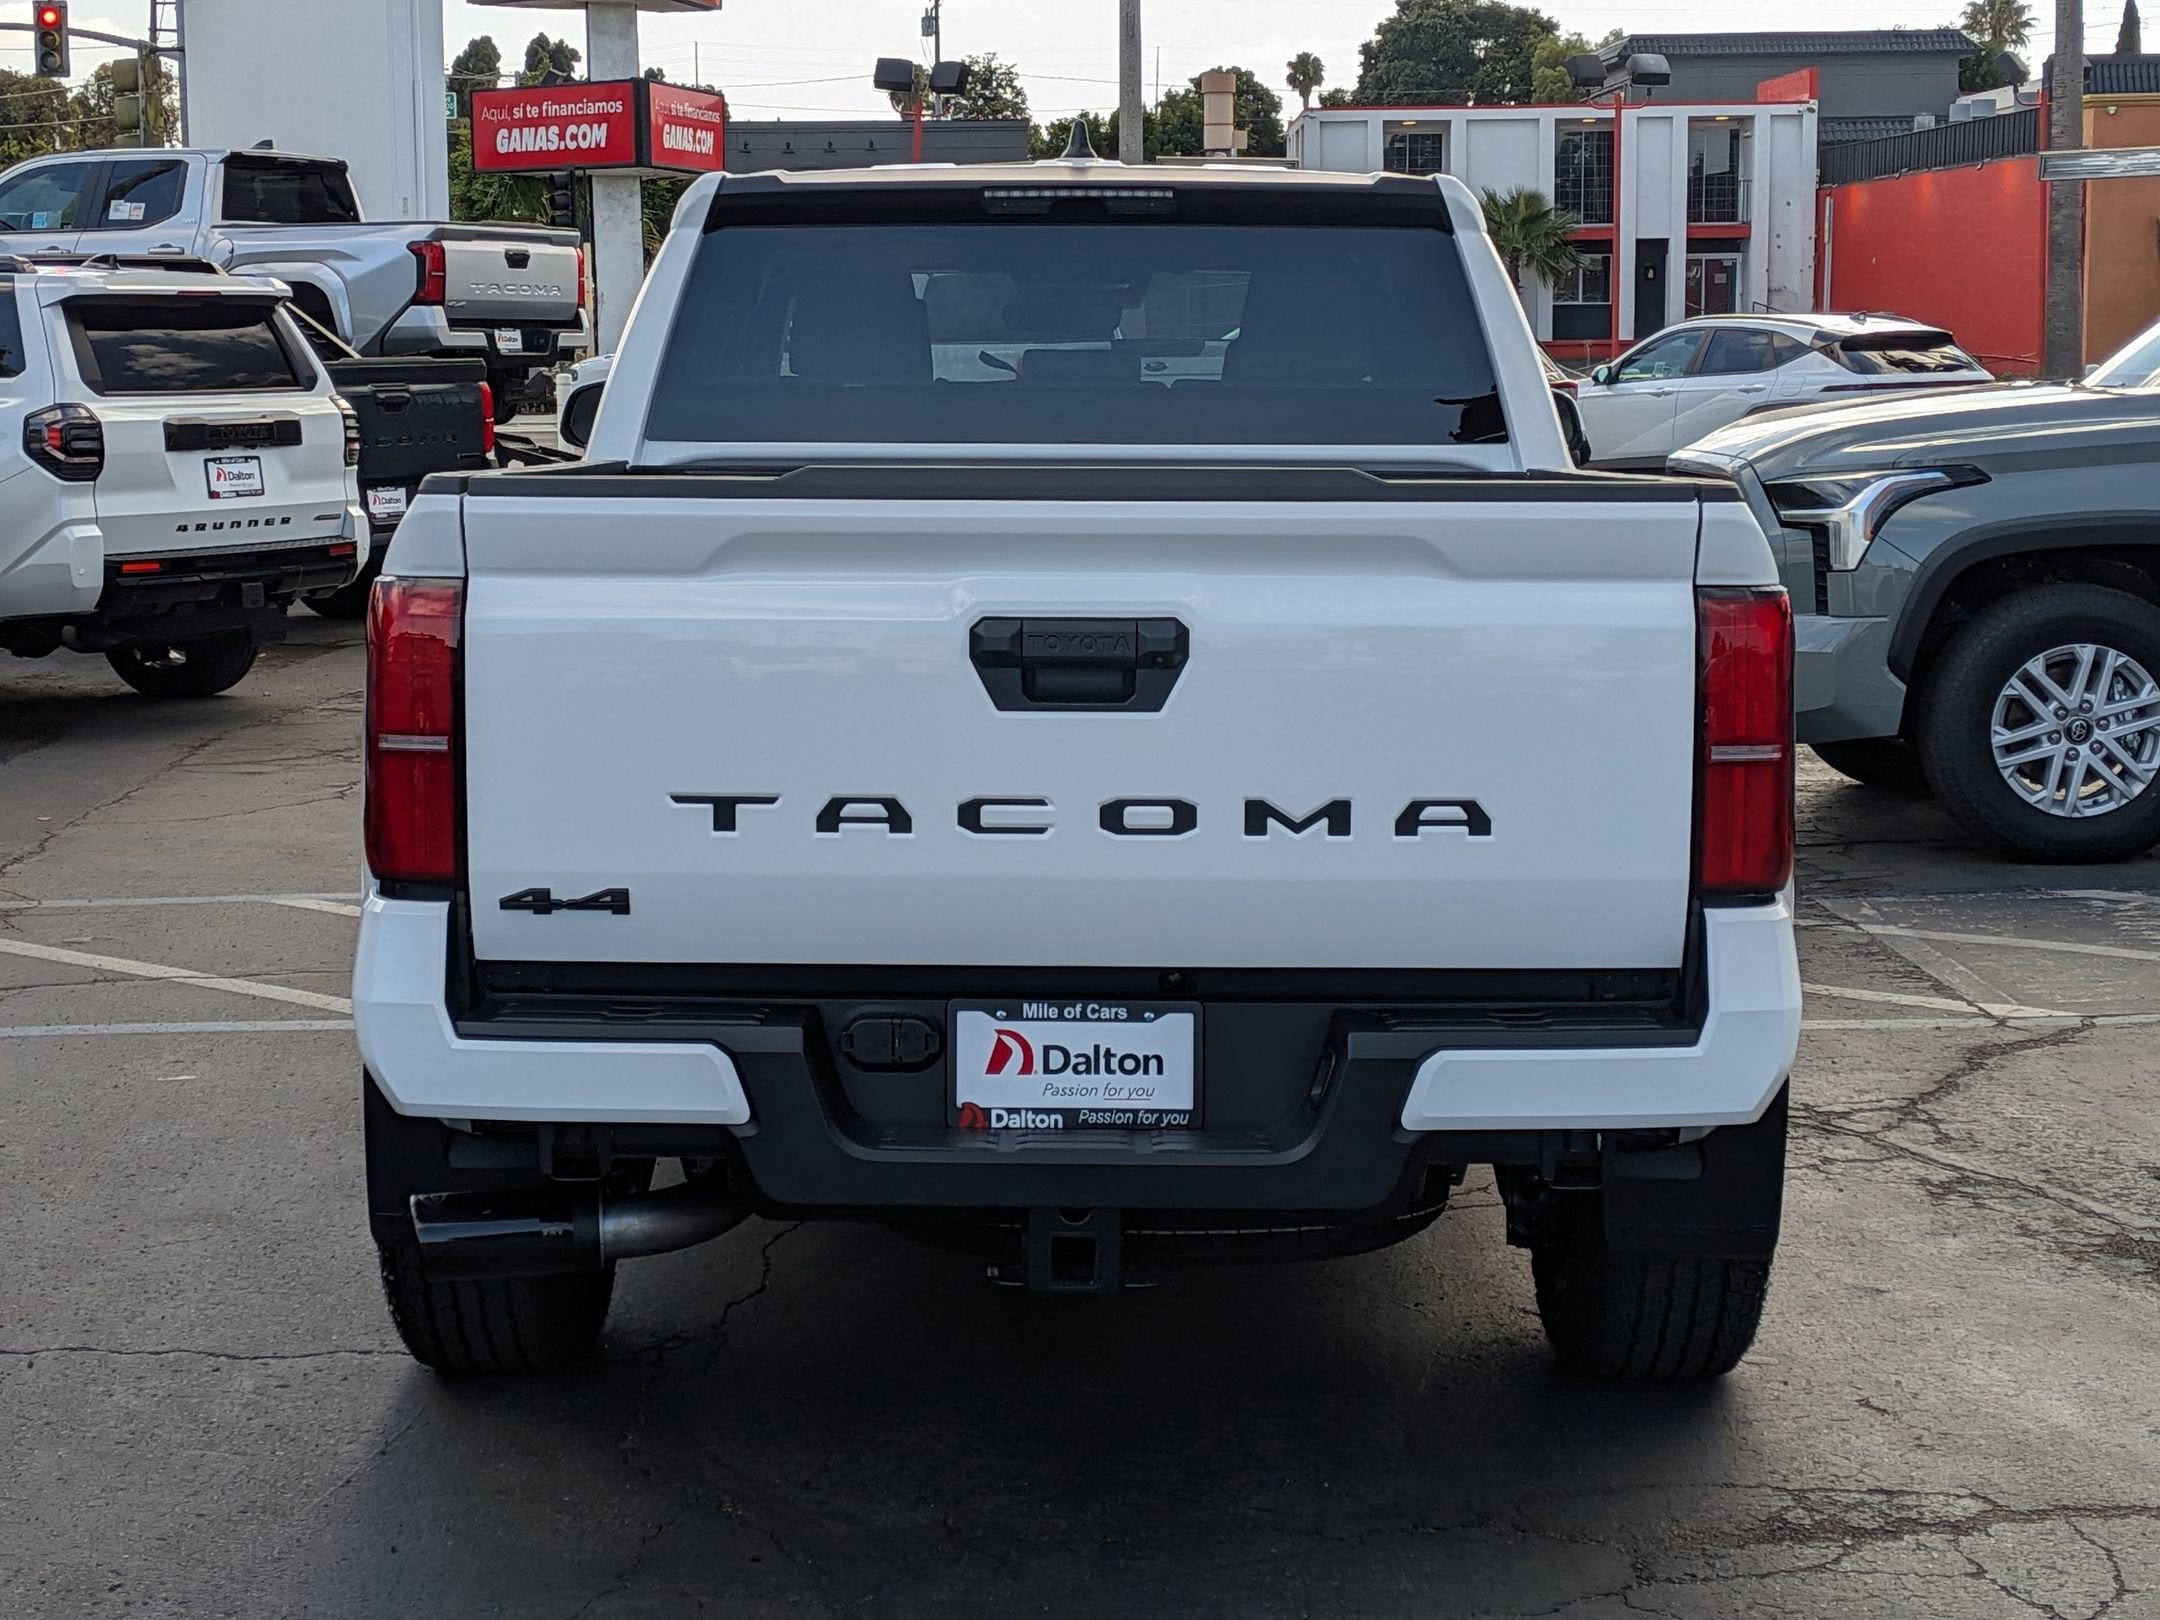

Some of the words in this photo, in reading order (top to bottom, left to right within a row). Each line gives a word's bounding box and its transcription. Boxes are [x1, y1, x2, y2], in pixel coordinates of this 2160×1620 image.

[481, 104, 511, 122] Aquí,
[513, 105, 524, 119] sí
[526, 104, 539, 118] te
[542, 98, 623, 117] financiamos
[496, 122, 607, 153] GANAS.COM
[663, 123, 714, 155] GANAS.COM
[470, 283, 561, 296] TACOMA
[227, 471, 255, 481] Dalton
[176, 516, 292, 533] 4RUNNER
[1027, 634, 1131, 653] TOYOTA
[669, 793, 1494, 837] TACOMA
[1023, 1003, 1058, 1019] Mile
[1063, 1003, 1082, 1019] of
[1086, 1004, 1128, 1020] Cars
[1042, 1044, 1164, 1076] Dalton
[1042, 1083, 1099, 1097] Passion
[1103, 1083, 1124, 1099] for
[1127, 1086, 1155, 1099] you
[991, 1109, 1063, 1129] Dalton
[1078, 1109, 1134, 1125] Passion
[1136, 1110, 1158, 1125] for
[1159, 1112, 1190, 1128] you
